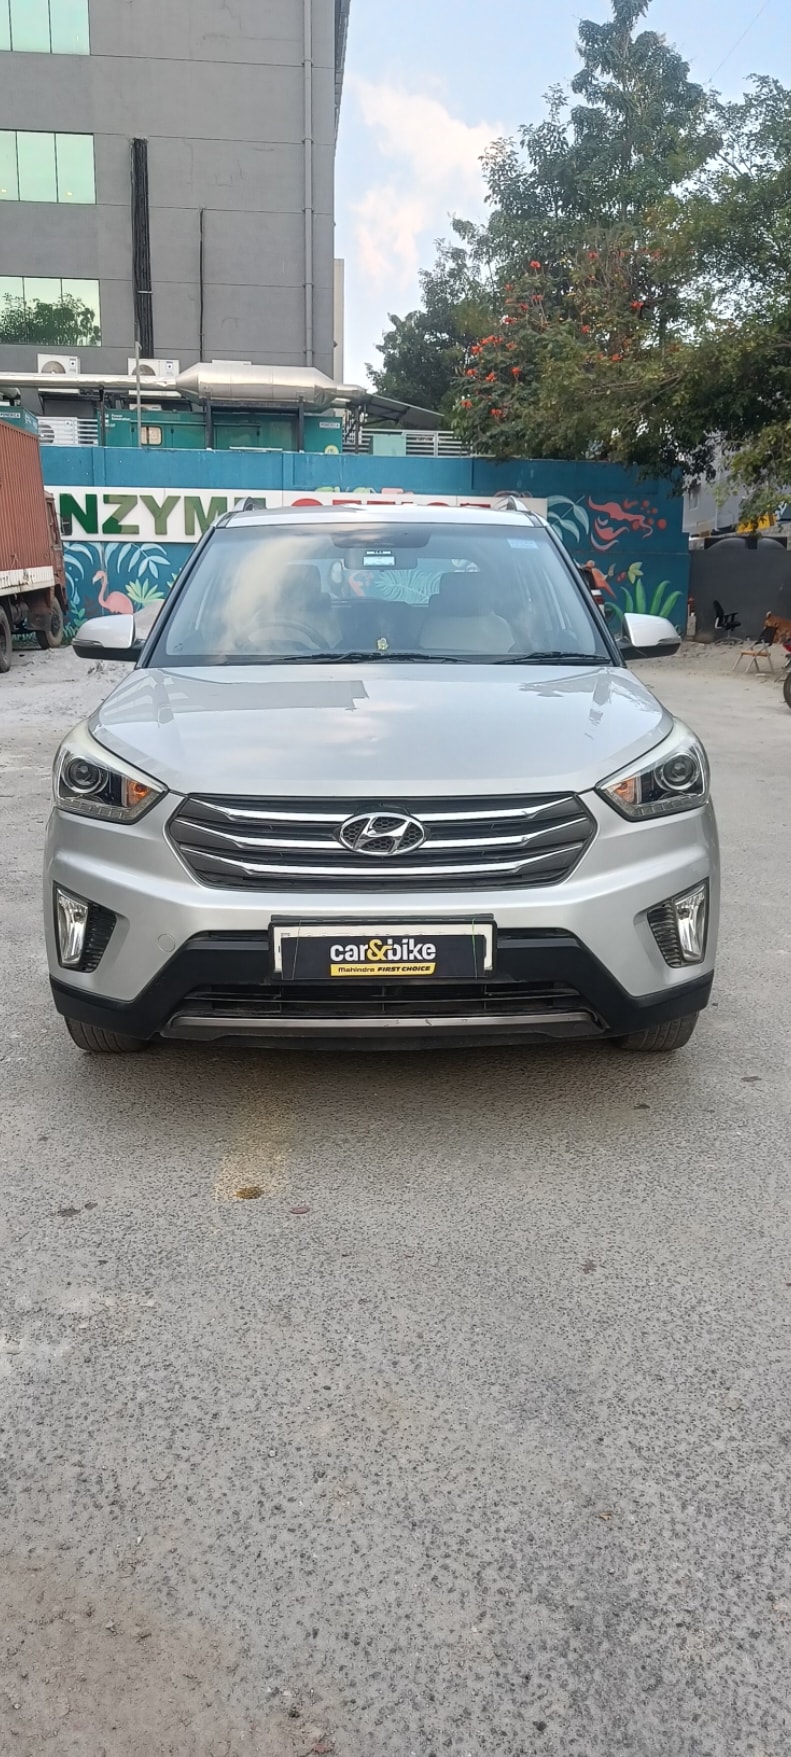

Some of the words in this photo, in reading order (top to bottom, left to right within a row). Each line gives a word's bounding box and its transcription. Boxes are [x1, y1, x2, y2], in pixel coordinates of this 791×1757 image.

[59, 493, 267, 536] NZYM
[330, 939, 437, 962] car&bike
[377, 965, 401, 973] FIRST
